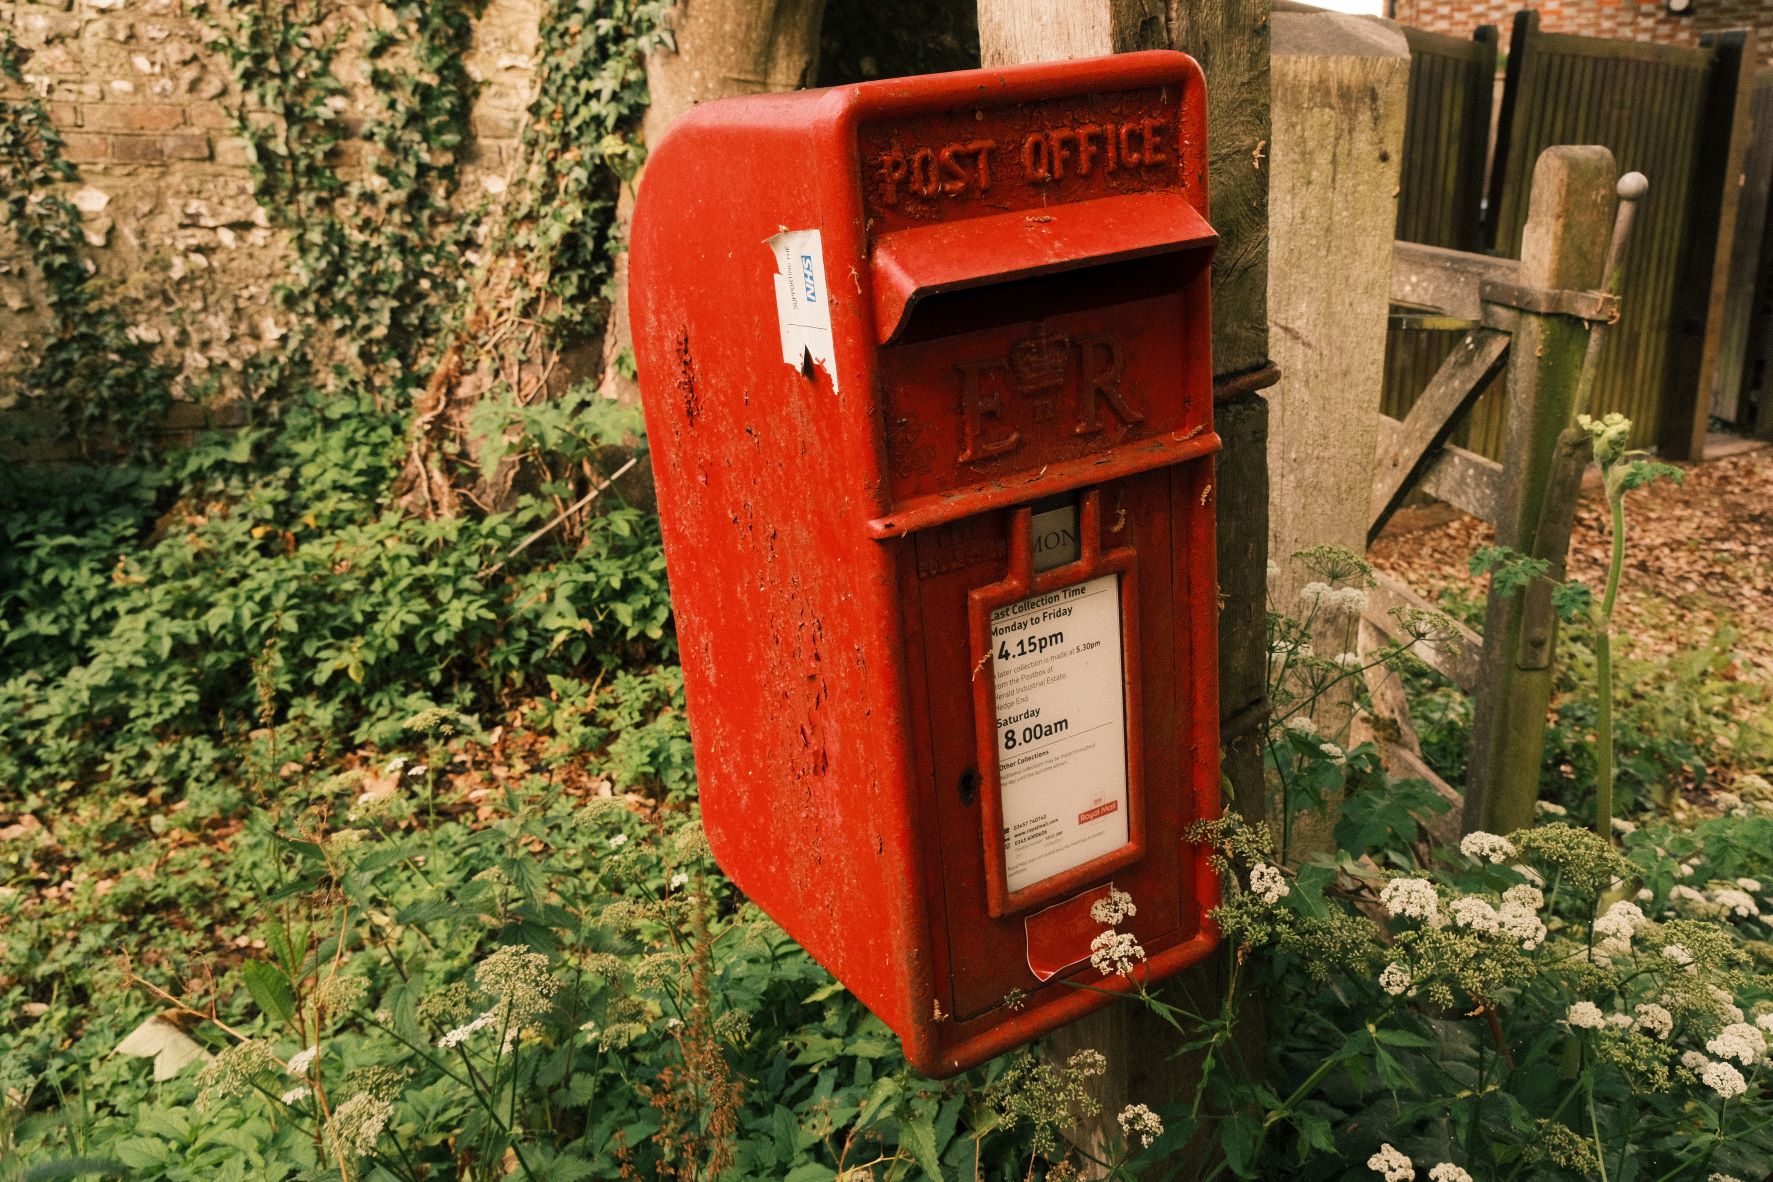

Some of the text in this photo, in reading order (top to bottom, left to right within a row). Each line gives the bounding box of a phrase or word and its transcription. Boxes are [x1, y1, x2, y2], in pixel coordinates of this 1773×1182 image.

[879, 117, 1168, 203] POST OFFICE
[787, 263, 798, 310] SUPPORTING
[801, 256, 816, 302] NHS
[991, 586, 1086, 621] ast Collection Time
[991, 606, 1073, 637] Monday to Friday
[997, 669, 1012, 679] later
[1013, 658, 1043, 673] collection
[1050, 651, 1068, 662] made
[1068, 648, 1075, 656] at
[1076, 640, 1101, 653] 5.30pm
[998, 630, 1064, 661] 4.15pm
[994, 666, 1053, 690] rom the Postbox at
[1016, 680, 1046, 694] Industrial
[1015, 695, 1029, 705] End
[996, 706, 1041, 728] Saturday
[1004, 718, 1068, 750] 8.00am
[1000, 750, 1049, 771] Other Collections
[1080, 802, 1116, 822] Royal Mail
